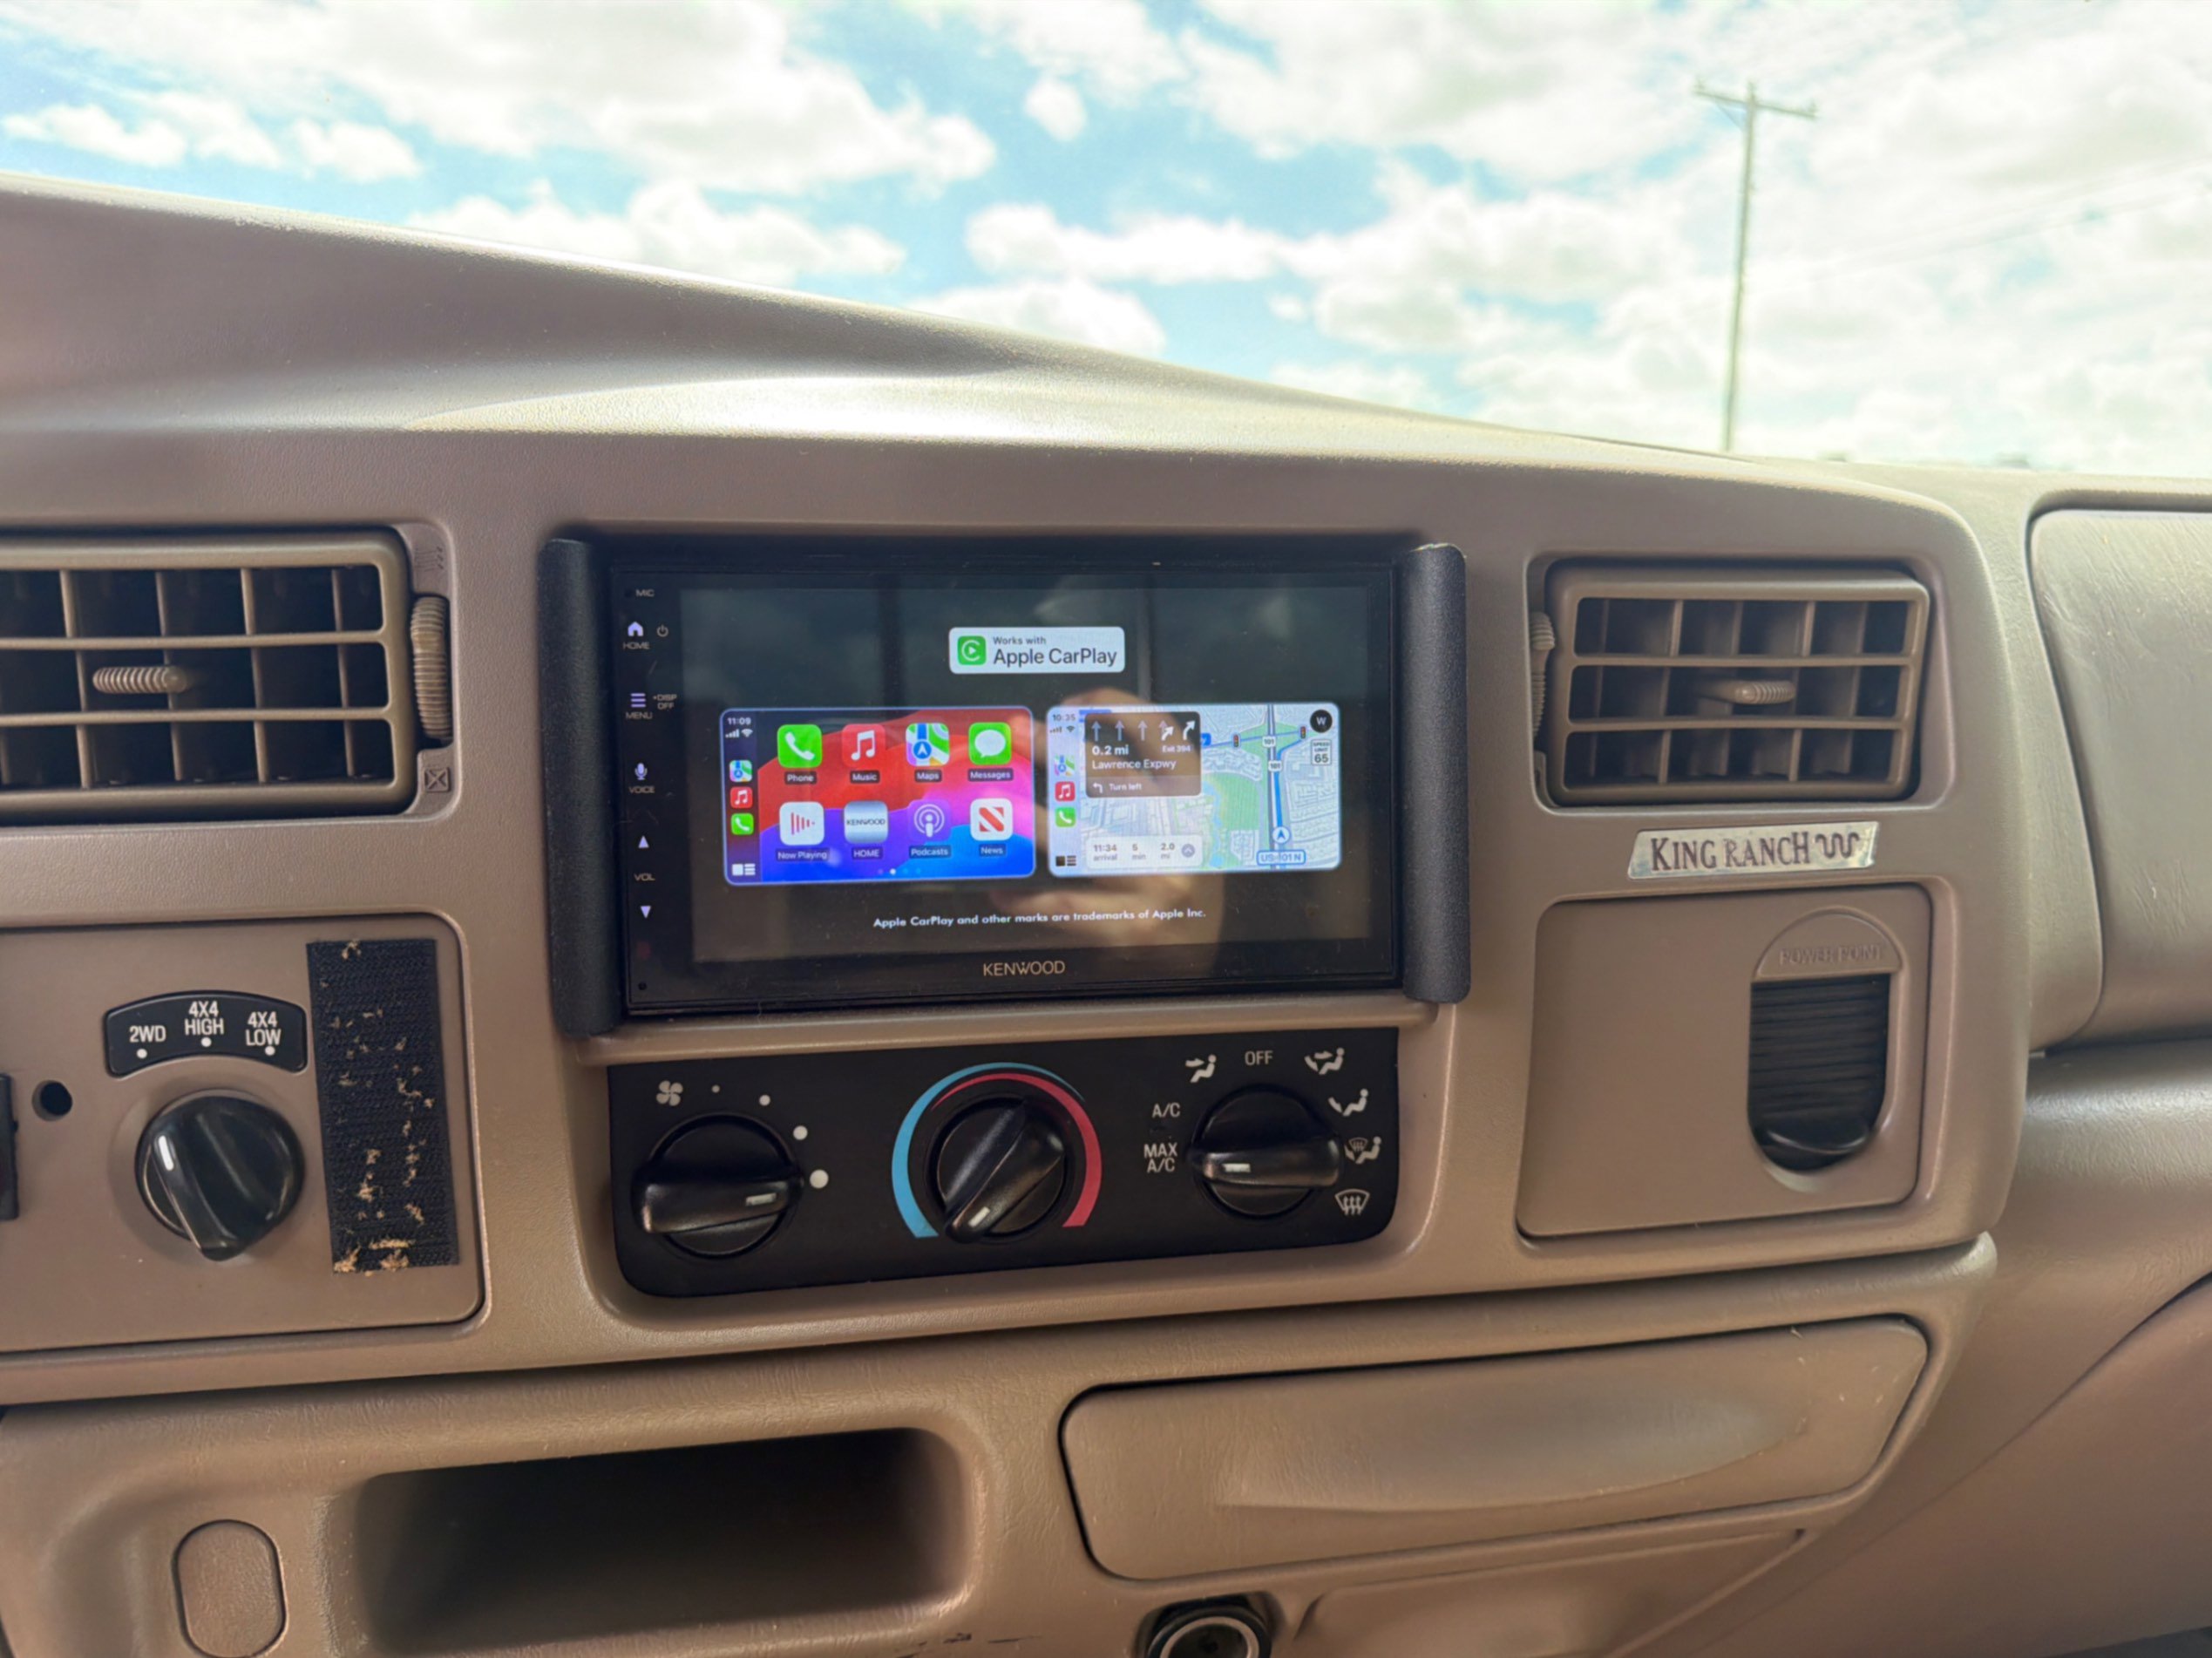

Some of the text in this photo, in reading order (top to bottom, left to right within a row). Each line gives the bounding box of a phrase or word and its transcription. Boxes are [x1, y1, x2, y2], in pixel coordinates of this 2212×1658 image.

[635, 588, 655, 597] MIC
[993, 648, 1117, 668] Apple CarPlay
[727, 717, 751, 725] 11:09
[1316, 717, 1327, 725] W
[1092, 744, 1130, 756] 0.2 mi
[1092, 758, 1177, 770] Lawrence Expwy
[1314, 753, 1329, 764] 65
[787, 773, 814, 783] Phone
[917, 772, 939, 782] Maps
[970, 771, 1011, 780] Messages
[1109, 783, 1127, 792] Turn
[846, 818, 885, 826] KENWOOD
[777, 850, 827, 861] Now Playing
[854, 849, 879, 858] HOME
[911, 847, 949, 856] Podcasts
[1651, 831, 1811, 872] KING RANCH
[873, 917, 906, 928] Apple
[910, 915, 954, 927] CarPlay
[957, 915, 979, 924] and
[981, 914, 1010, 924] other
[1014, 913, 1048, 922] marks
[1073, 911, 1135, 921] trademarks
[1137, 909, 1150, 919] of
[1152, 908, 1184, 921] Apple
[1187, 907, 1206, 918] Inc.
[1779, 944, 1882, 965] POWER POINT
[983, 961, 1066, 976] KENWOOD
[188, 1001, 219, 1017] 4X4
[248, 1011, 278, 1029] 4X4
[185, 1018, 224, 1036] HIGH
[129, 1025, 166, 1043] 2WD
[245, 1029, 282, 1046] LOW
[1245, 1050, 1273, 1065] OFF
[1152, 1103, 1181, 1118] A/C
[1143, 1143, 1177, 1159] MAX
[1147, 1158, 1175, 1173] A/C
